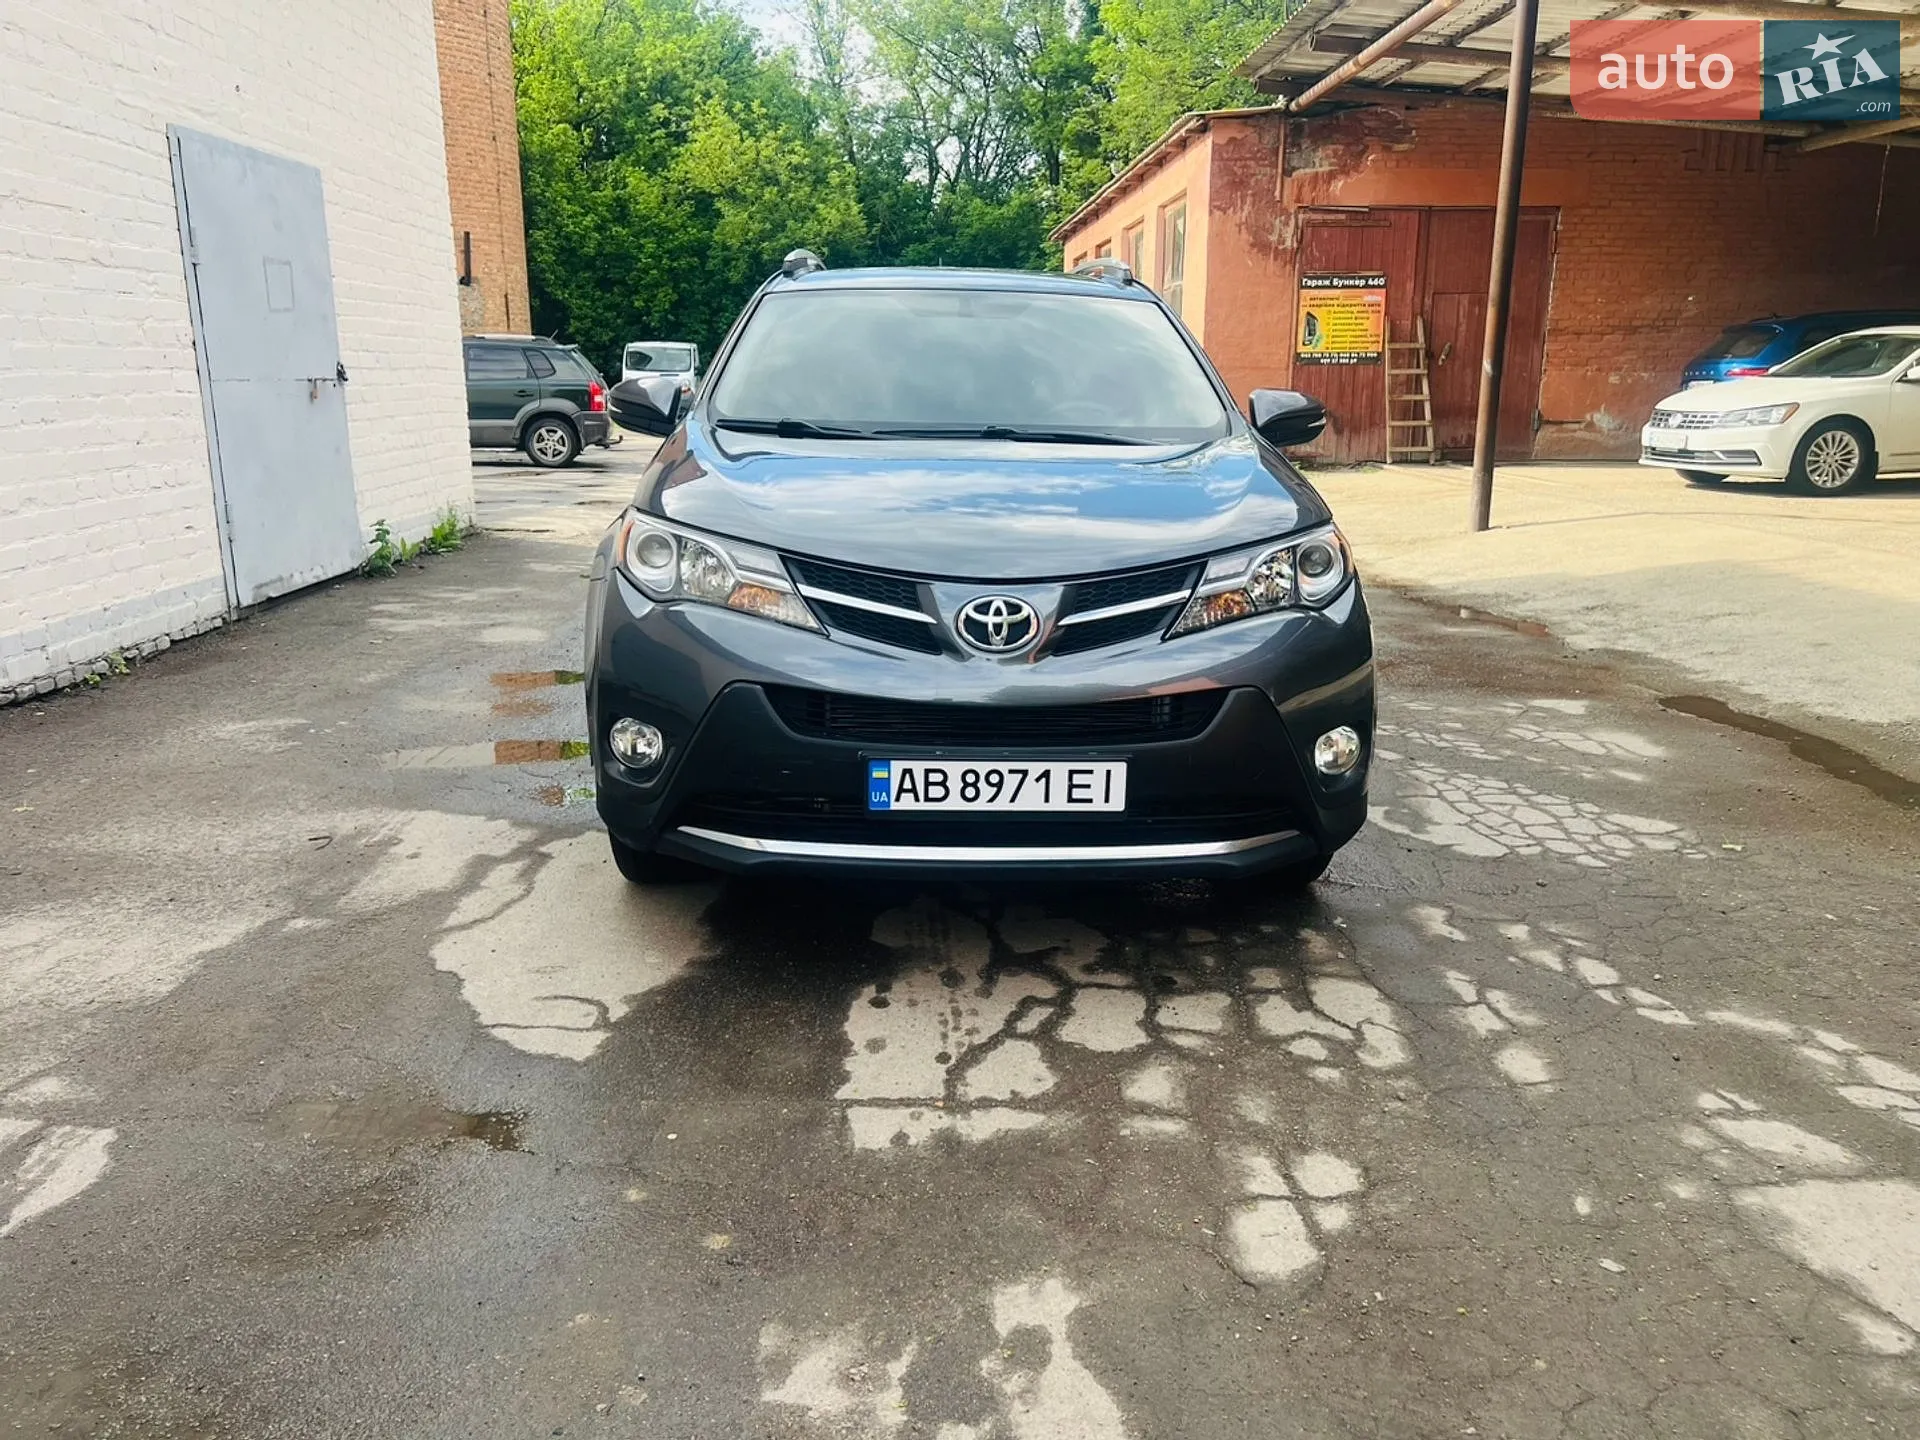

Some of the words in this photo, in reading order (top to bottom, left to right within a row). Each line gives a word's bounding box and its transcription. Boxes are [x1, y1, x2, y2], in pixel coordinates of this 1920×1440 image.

[1302, 278, 1331, 287] Гараж
[1333, 278, 1366, 287] Бункер
[1367, 277, 1385, 286] 460
[871, 791, 889, 803] UA
[894, 768, 950, 803] AB
[960, 769, 1051, 804] 8971
[1067, 769, 1112, 804] EI
